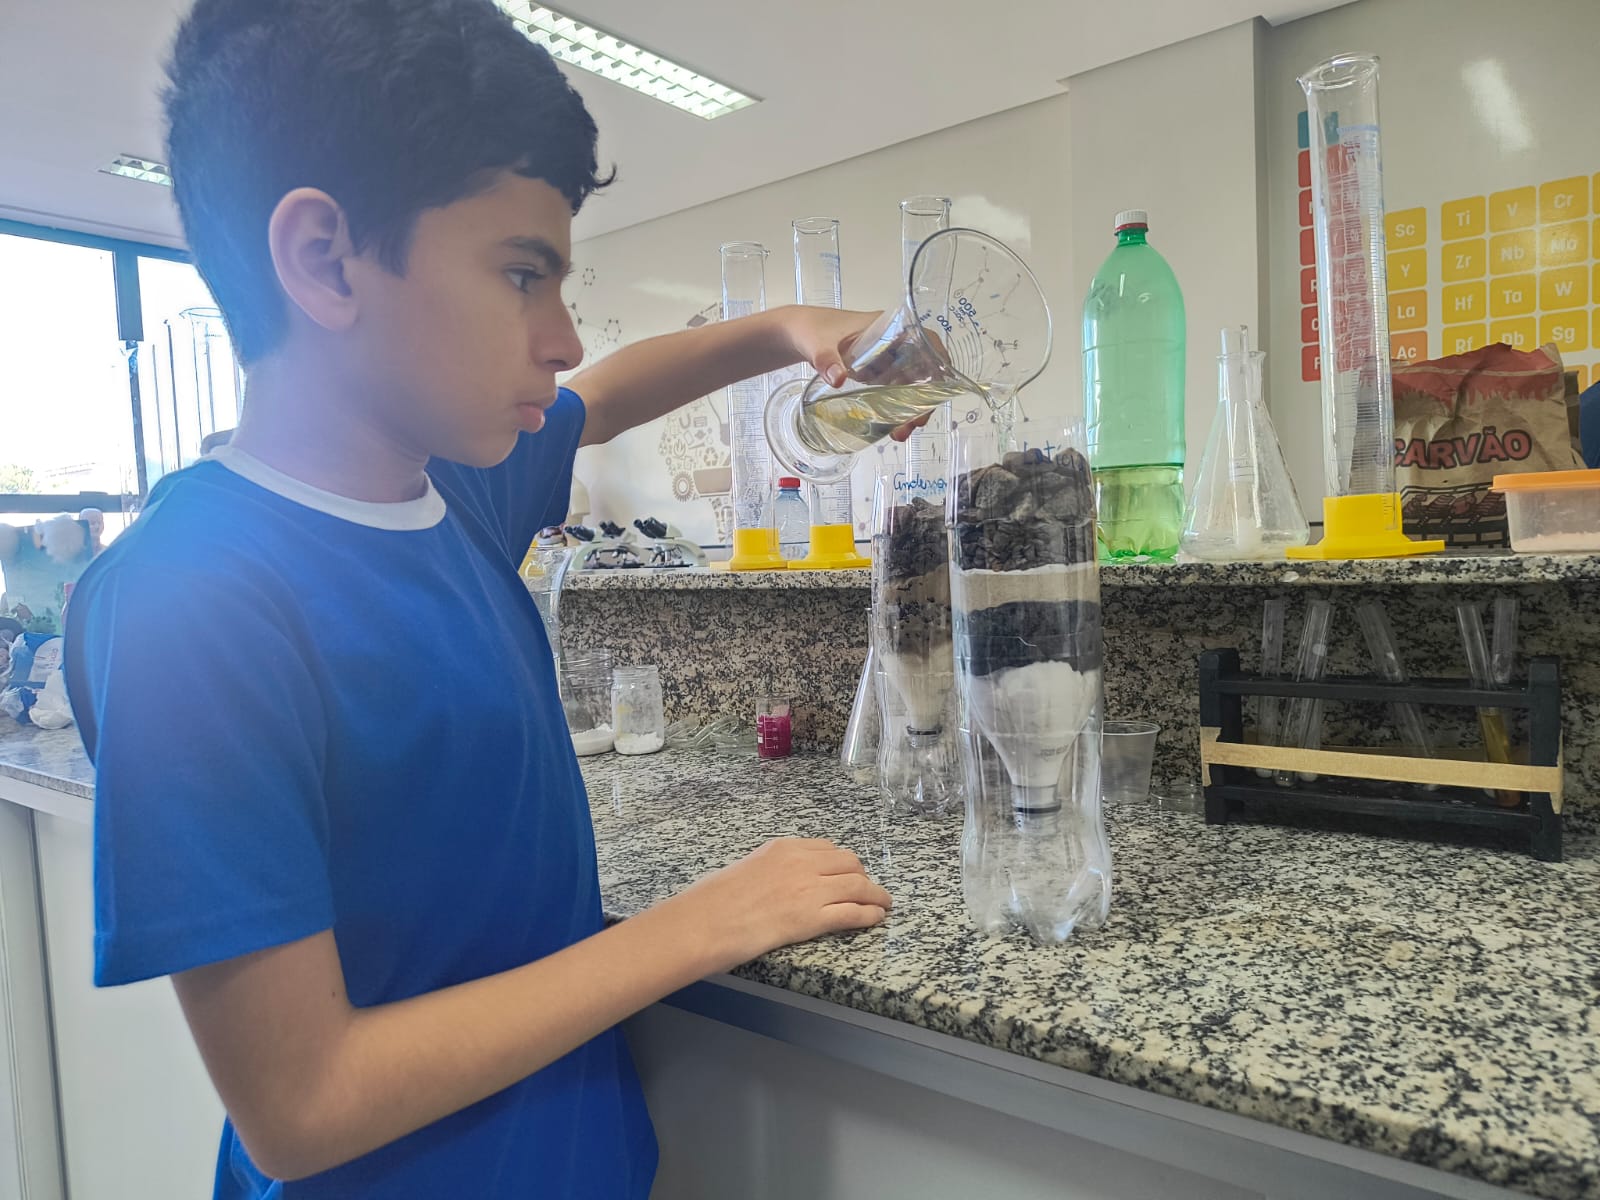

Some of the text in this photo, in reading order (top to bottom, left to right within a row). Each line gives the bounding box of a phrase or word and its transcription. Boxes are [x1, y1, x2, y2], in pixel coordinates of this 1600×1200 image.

[1395, 193, 1574, 238] Sc Ti V Cr
[1400, 237, 1578, 278] Y Zr Nb Mo
[1397, 280, 1574, 319] La Hf Ta W
[1397, 325, 1575, 360] Ac Rf Db Sg
